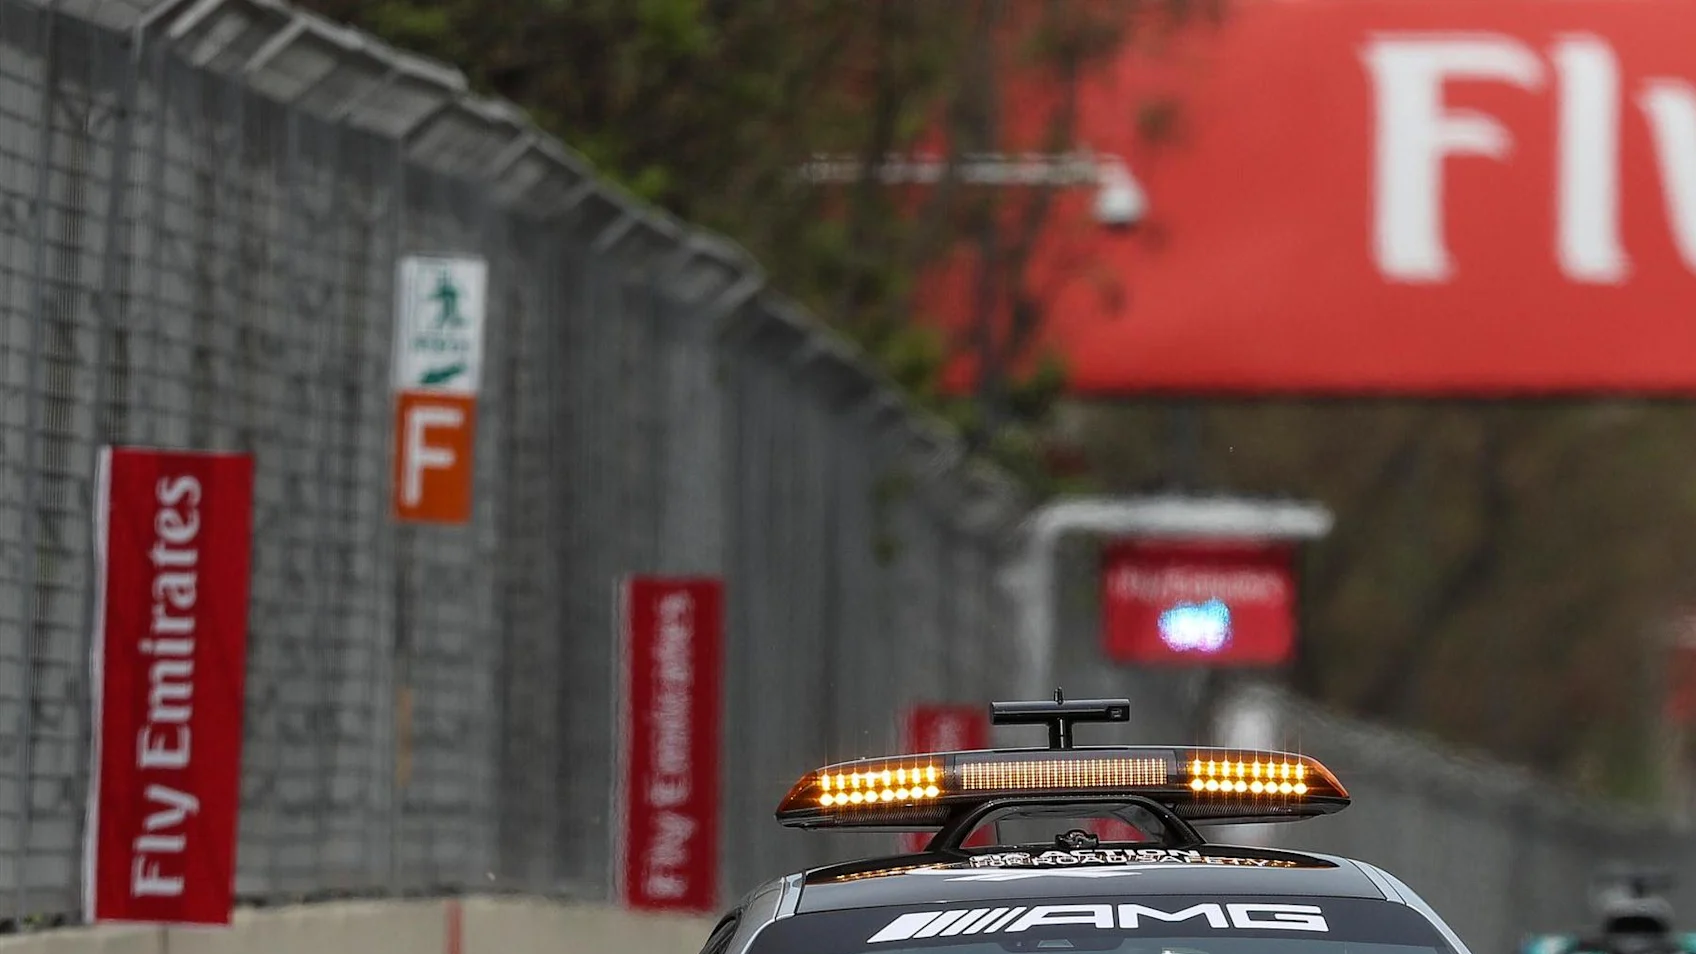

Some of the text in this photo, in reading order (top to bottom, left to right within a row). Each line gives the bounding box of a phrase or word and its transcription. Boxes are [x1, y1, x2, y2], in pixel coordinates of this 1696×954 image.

[403, 408, 464, 507] F
[131, 474, 202, 896] Fly Emirates
[1032, 855, 1128, 866] ROAD
[1005, 903, 1330, 933] AMG
